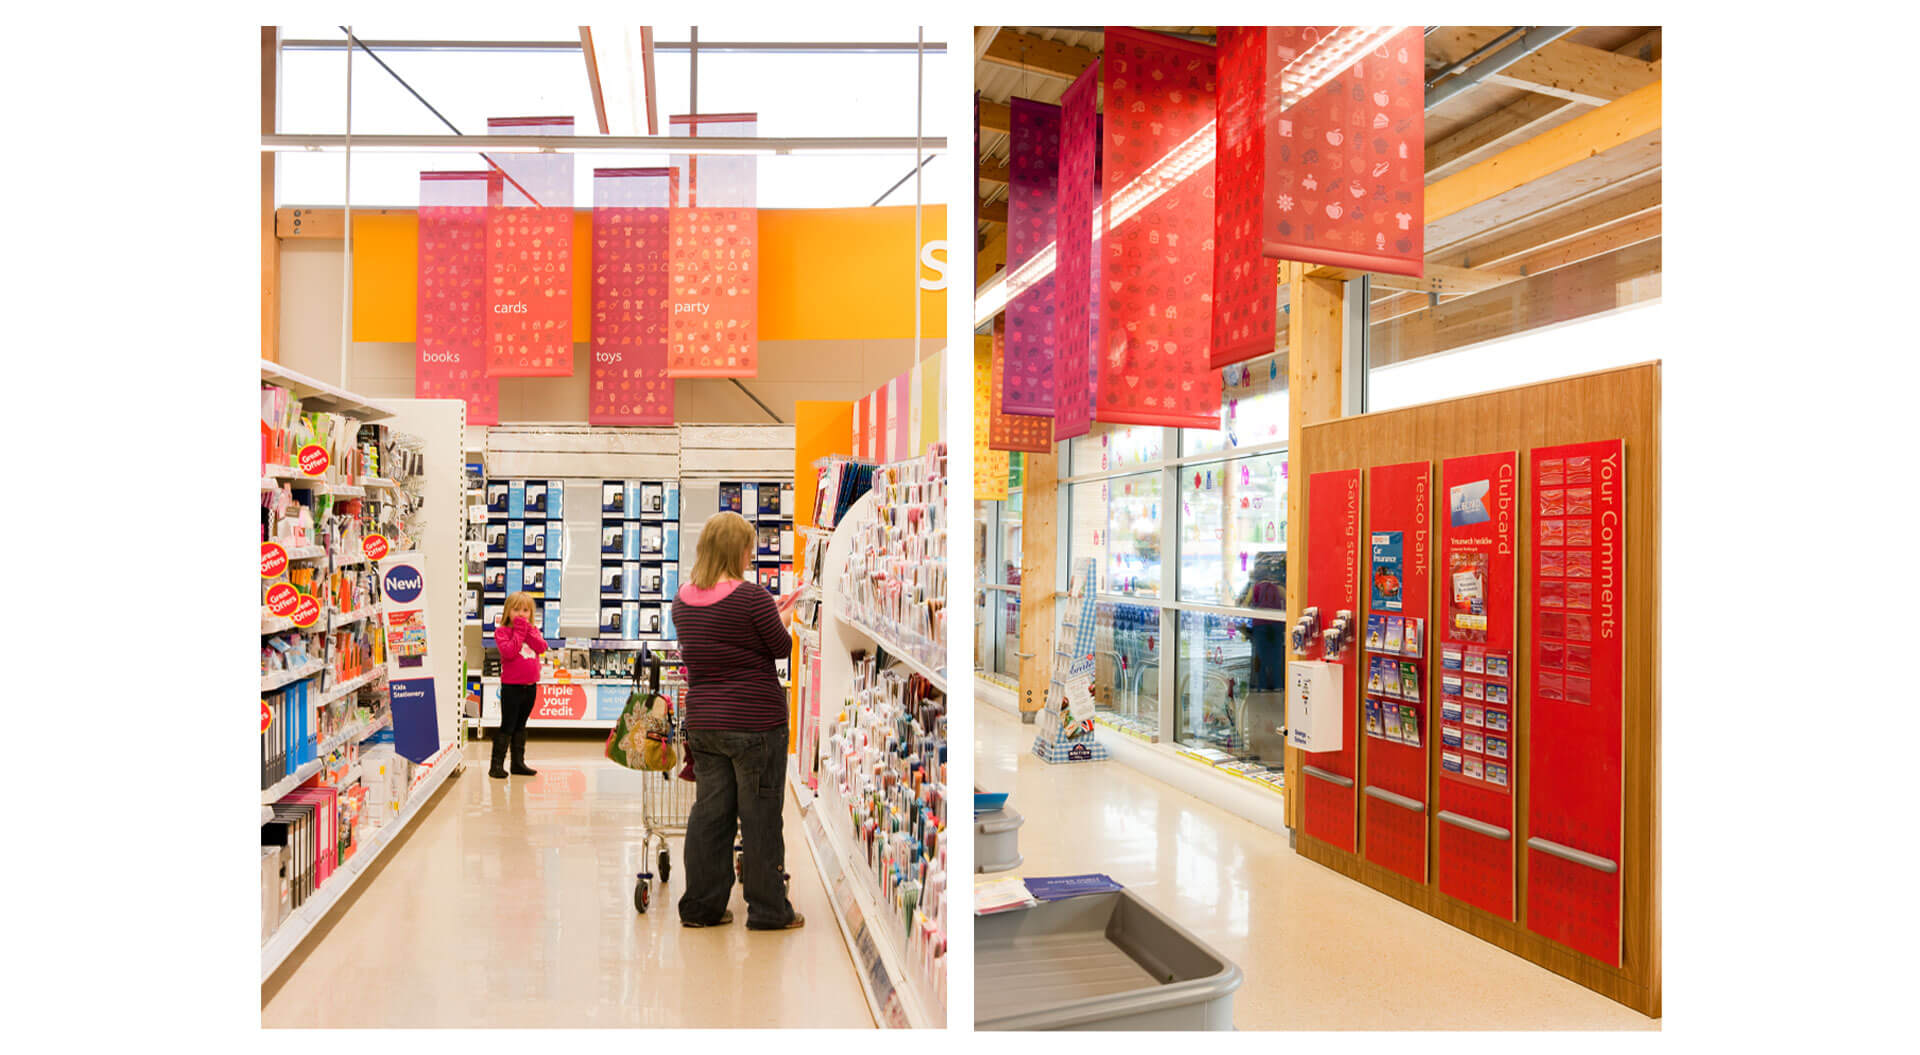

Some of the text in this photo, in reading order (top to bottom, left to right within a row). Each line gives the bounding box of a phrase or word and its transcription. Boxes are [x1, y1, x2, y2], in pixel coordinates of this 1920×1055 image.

[494, 301, 528, 314] cards
[674, 302, 710, 315] party
[422, 350, 460, 363] books
[596, 351, 622, 365] toys
[302, 449, 322, 463] Great
[305, 457, 327, 472] Offers
[1498, 463, 1512, 555] Clubcard
[1416, 472, 1428, 576] Tesco bank
[365, 538, 382, 549] Great
[1344, 478, 1358, 603] Saving stamps
[1601, 452, 1617, 639] Your Comments
[261, 548, 279, 562] reat
[261, 557, 285, 572] Offers
[386, 575, 421, 591] New!
[270, 588, 290, 603] Great
[273, 596, 297, 612] Offers
[542, 684, 573, 697] Triple
[544, 697, 571, 707] your
[539, 705, 573, 716] credit
